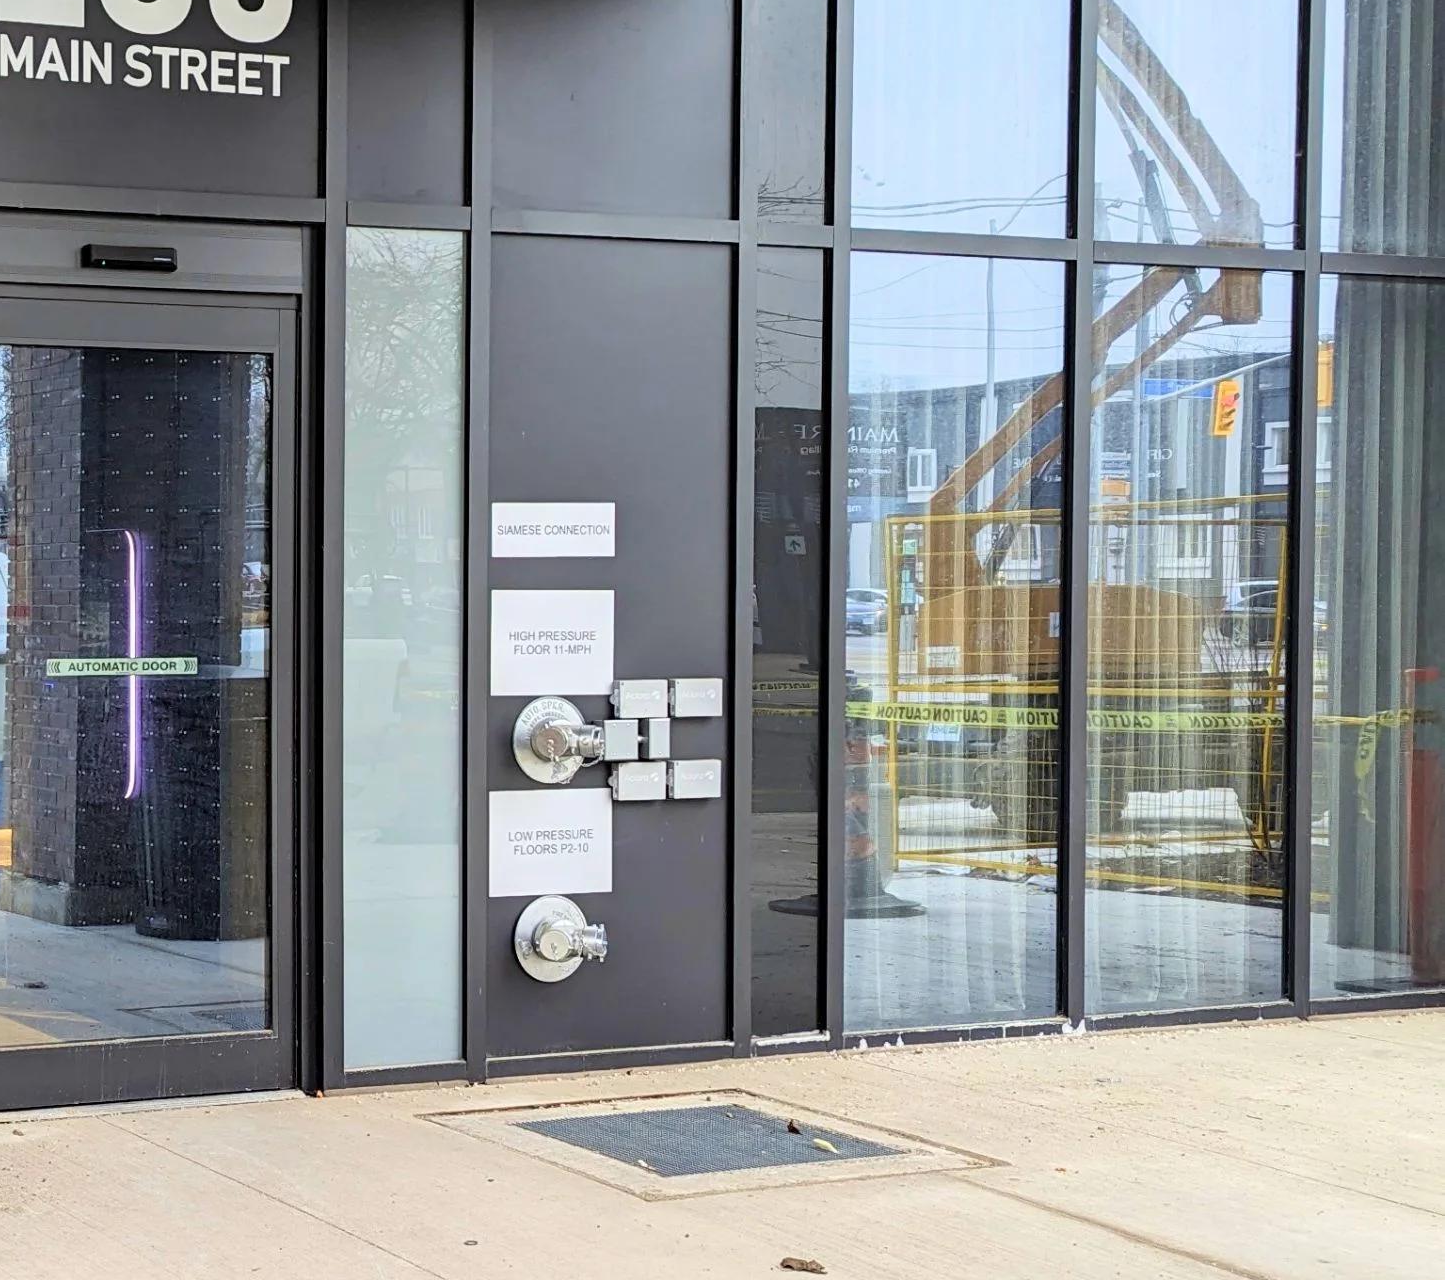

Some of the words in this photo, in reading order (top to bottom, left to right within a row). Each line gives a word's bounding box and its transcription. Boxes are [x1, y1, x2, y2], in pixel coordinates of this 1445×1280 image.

[0, 34, 112, 85] MAIN
[123, 44, 290, 97] STREET
[497, 524, 542, 535] SIAMESE
[544, 524, 610, 535] CONNECTION
[509, 631, 536, 641] HIGH
[538, 630, 597, 641] PRESSURE
[514, 644, 551, 655] FLOOR
[554, 644, 592, 655] 11-MPH
[68, 662, 138, 672] AUTOMATIC
[142, 661, 177, 671] DOOR
[508, 831, 533, 842] LOW
[536, 828, 594, 841] PRESSURE
[514, 843, 558, 855] FLOORS
[560, 842, 589, 853] P2-10
